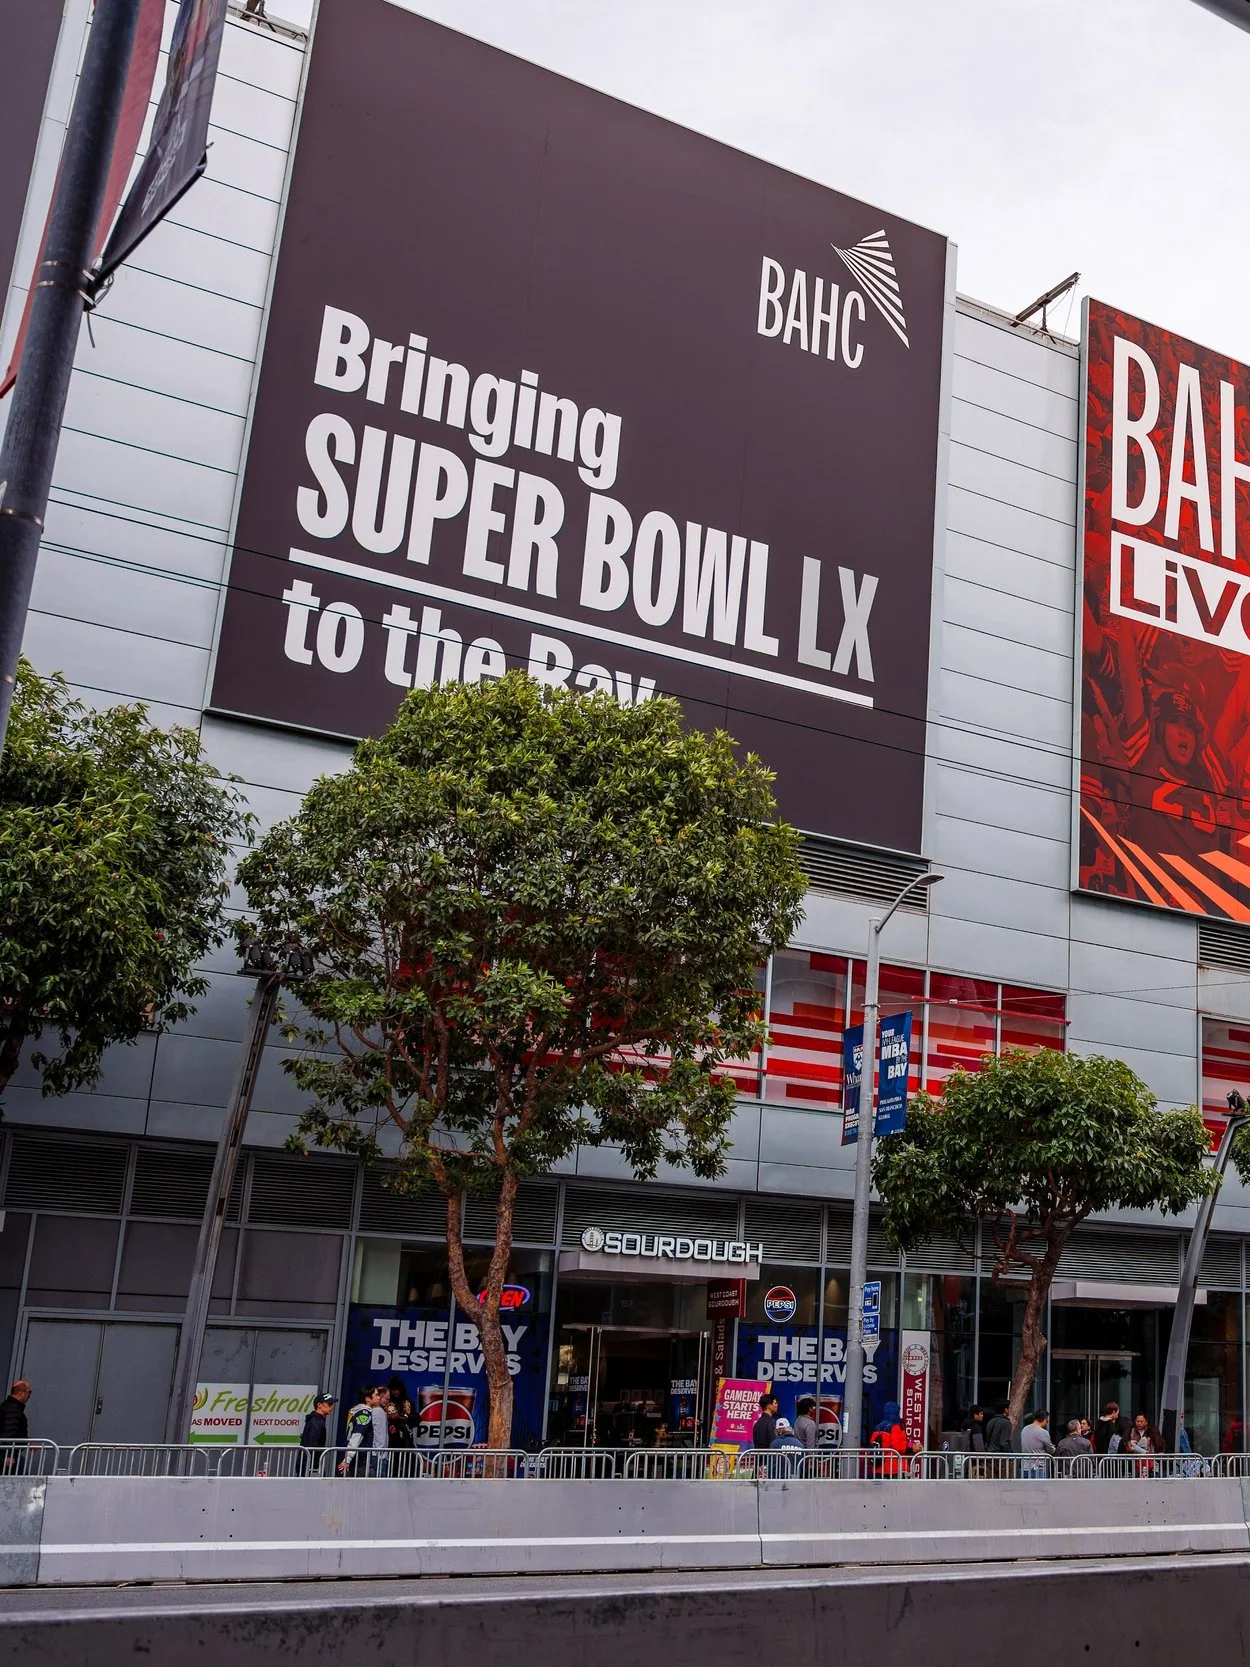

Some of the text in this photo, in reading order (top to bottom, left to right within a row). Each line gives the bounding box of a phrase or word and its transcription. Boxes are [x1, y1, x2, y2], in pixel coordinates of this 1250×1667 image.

[758, 256, 866, 368] BAHC
[314, 304, 622, 490] Bringing
[296, 412, 880, 683] SUPER BOWL LX
[281, 578, 365, 674] to
[382, 603, 507, 692] the
[881, 1042, 908, 1060] MBA
[887, 1062, 907, 1080] BAY
[604, 1232, 763, 1263] SOURDOUGH
[708, 1299, 739, 1308] SOURDOUGH
[766, 1300, 794, 1309] PEPSI
[373, 1318, 528, 1352] THE BY
[715, 1318, 726, 1360] Salads
[758, 1335, 881, 1363] THE BY
[370, 1348, 522, 1375] DESERVS
[714, 1365, 723, 1375] &
[757, 1361, 878, 1384] DESERVS
[671, 1380, 684, 1388] THE
[210, 1388, 317, 1413] Freshroll
[723, 1401, 760, 1412] STARTS
[724, 1389, 763, 1403] GAMEDAY
[914, 1378, 922, 1423] WEST
[191, 1418, 300, 1426] AS MOVED NEXT DOOR!
[726, 1411, 752, 1420] HERE
[416, 1425, 471, 1439] PEPSI
